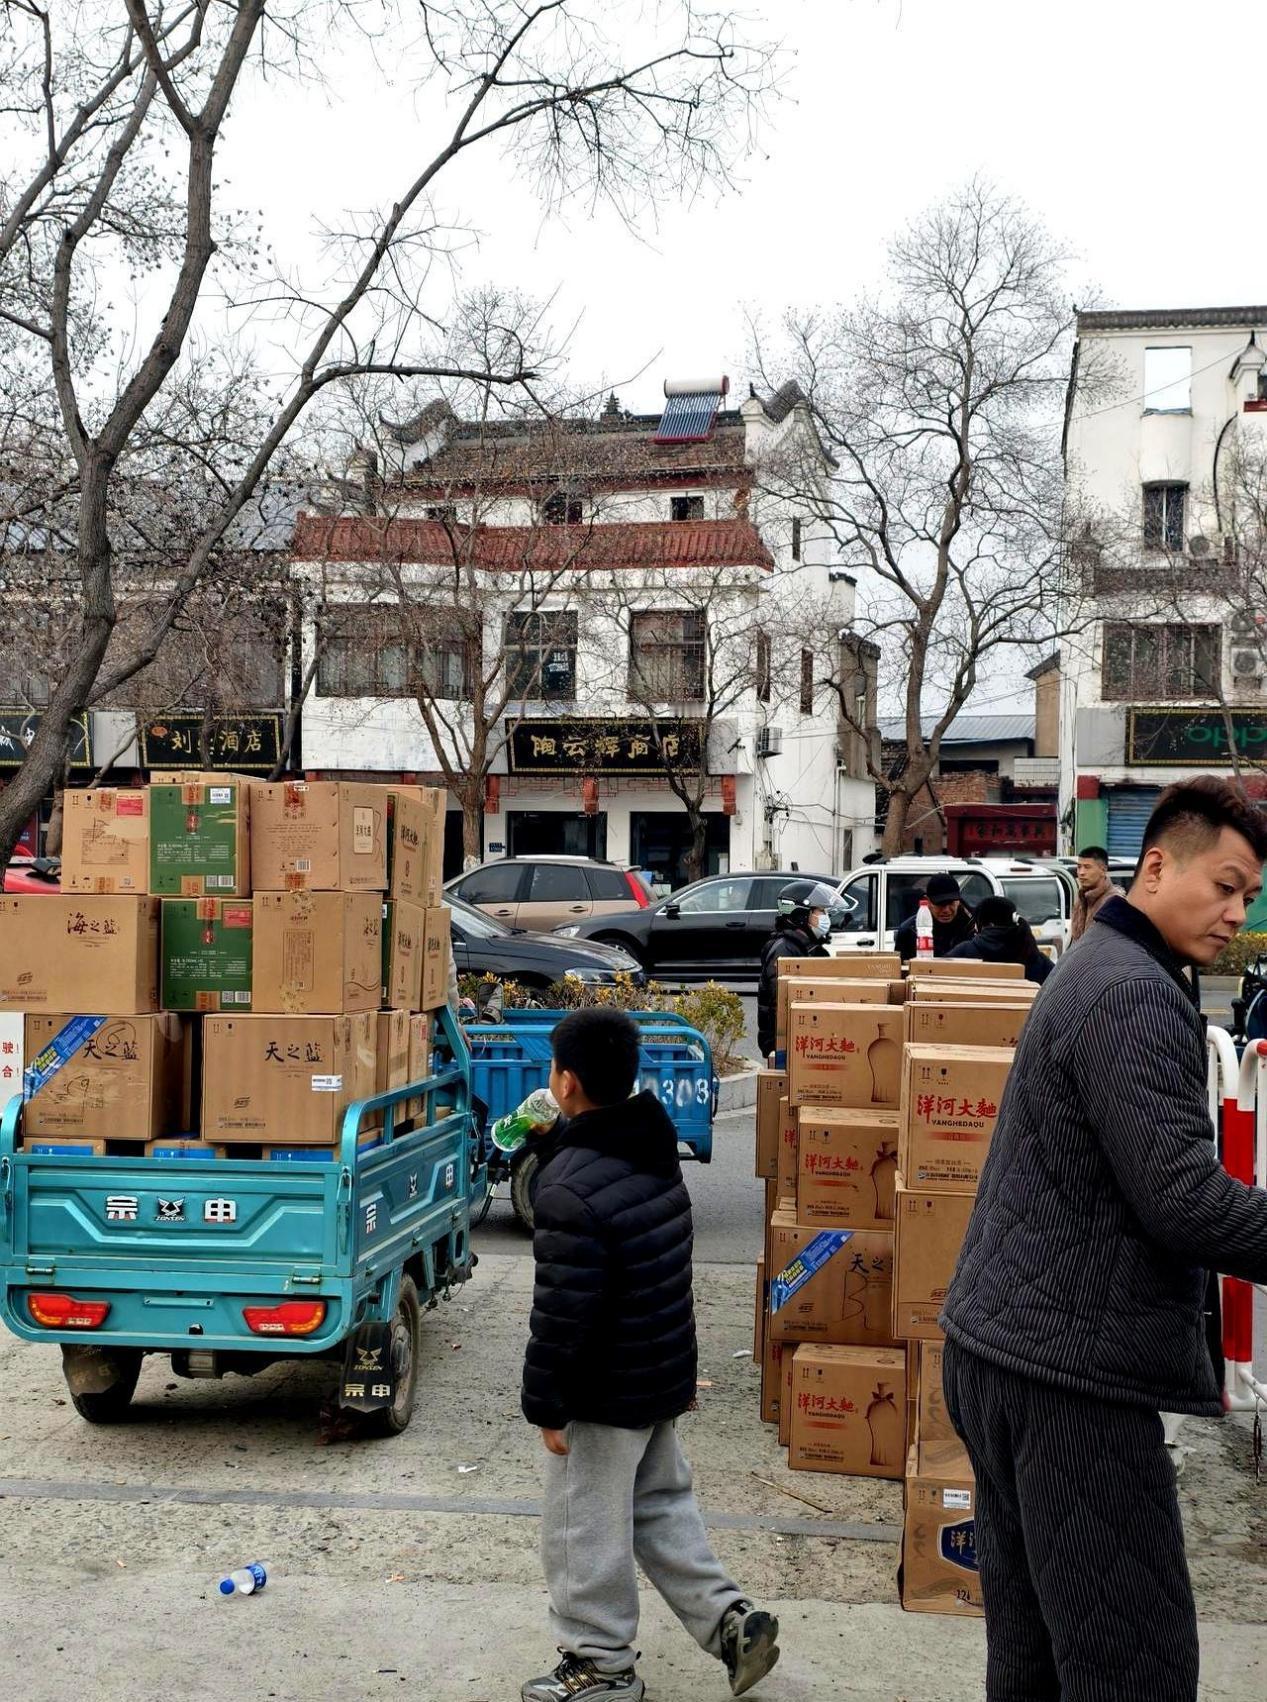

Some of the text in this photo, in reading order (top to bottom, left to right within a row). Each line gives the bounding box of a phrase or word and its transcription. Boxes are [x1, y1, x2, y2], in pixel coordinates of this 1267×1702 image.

[172, 730, 262, 754] 刘酒店
[106, 1195, 237, 1223] 宗 申
[848, 1253, 894, 1275] 天之
[345, 1383, 390, 1397] 宗 申
